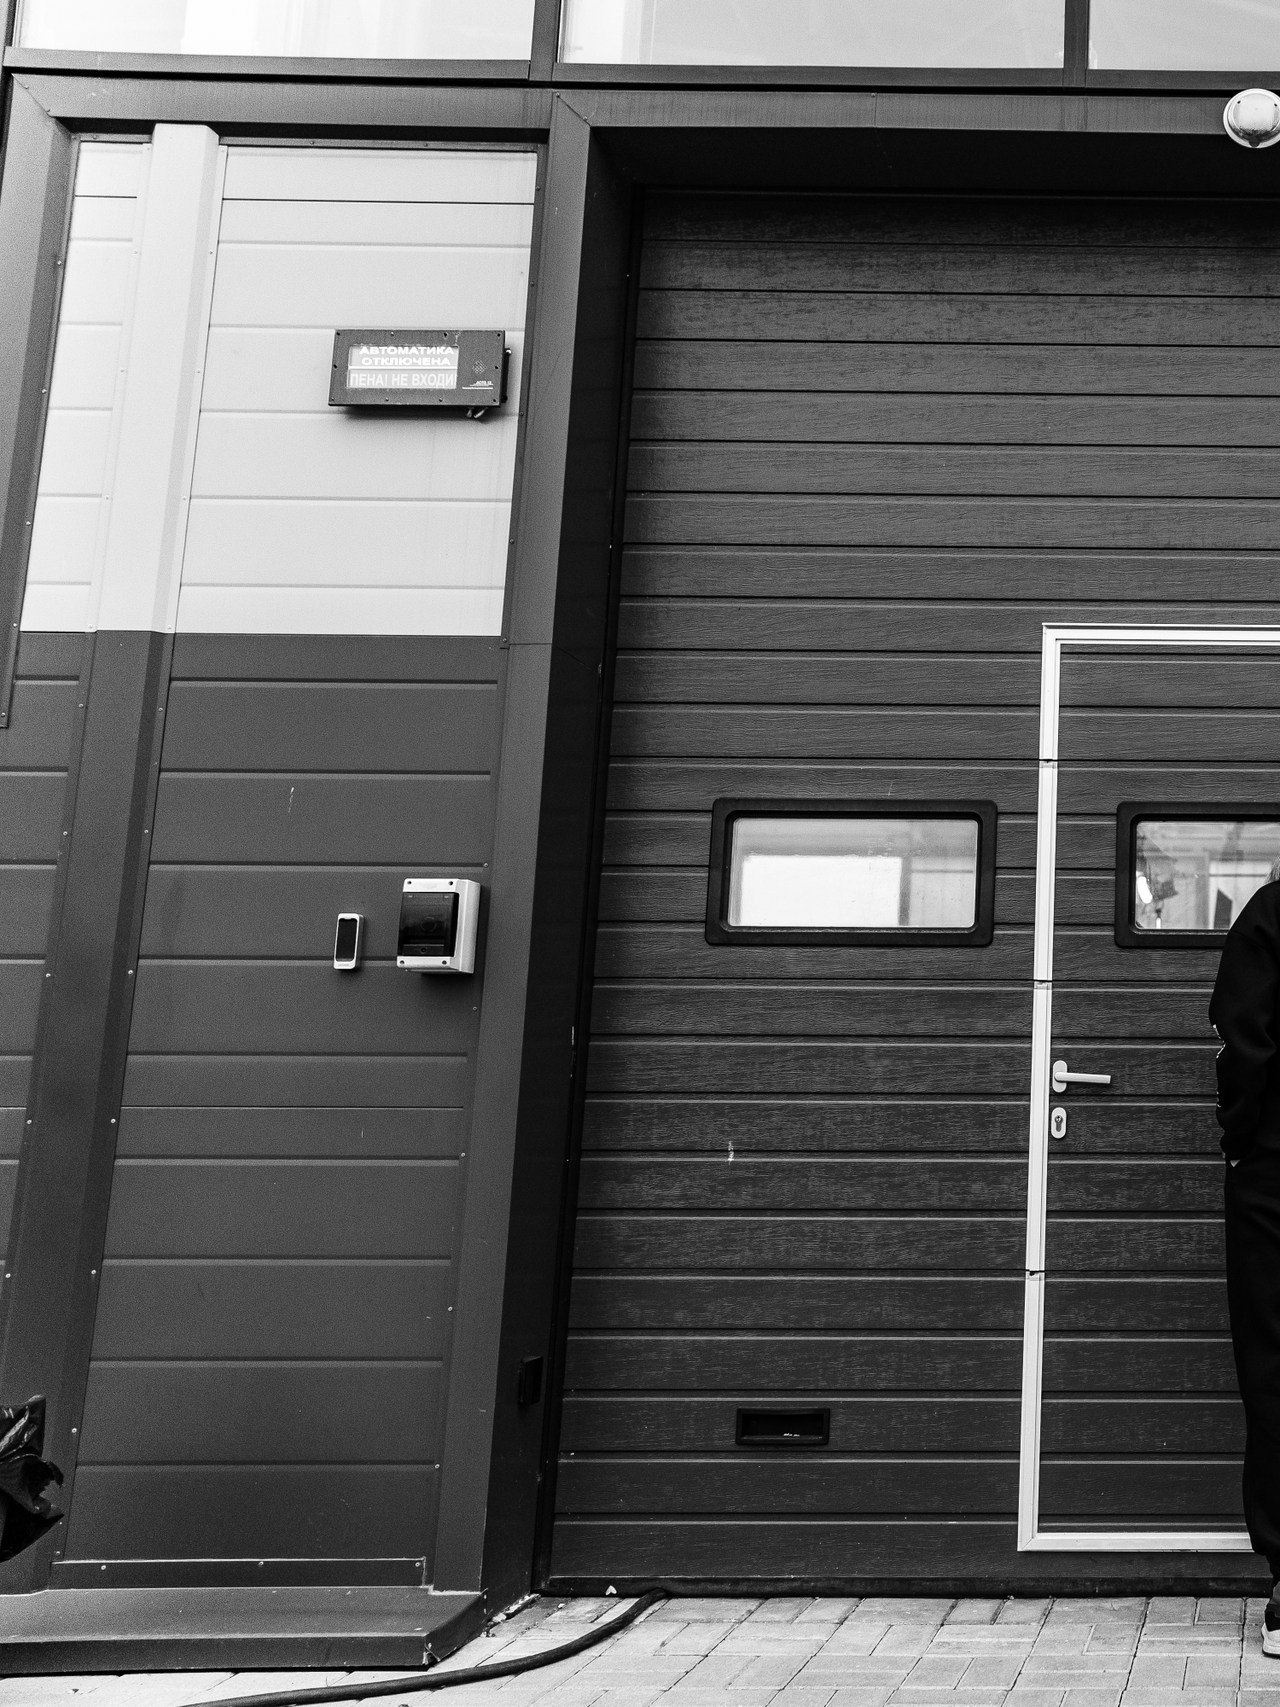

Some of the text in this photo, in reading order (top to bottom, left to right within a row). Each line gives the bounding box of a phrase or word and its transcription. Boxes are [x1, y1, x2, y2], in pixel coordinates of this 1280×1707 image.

[360, 346, 455, 355] АВТОМАТИКА
[361, 357, 451, 366] ОТКЛЮЧЕНА
[391, 373, 409, 386] НЕ
